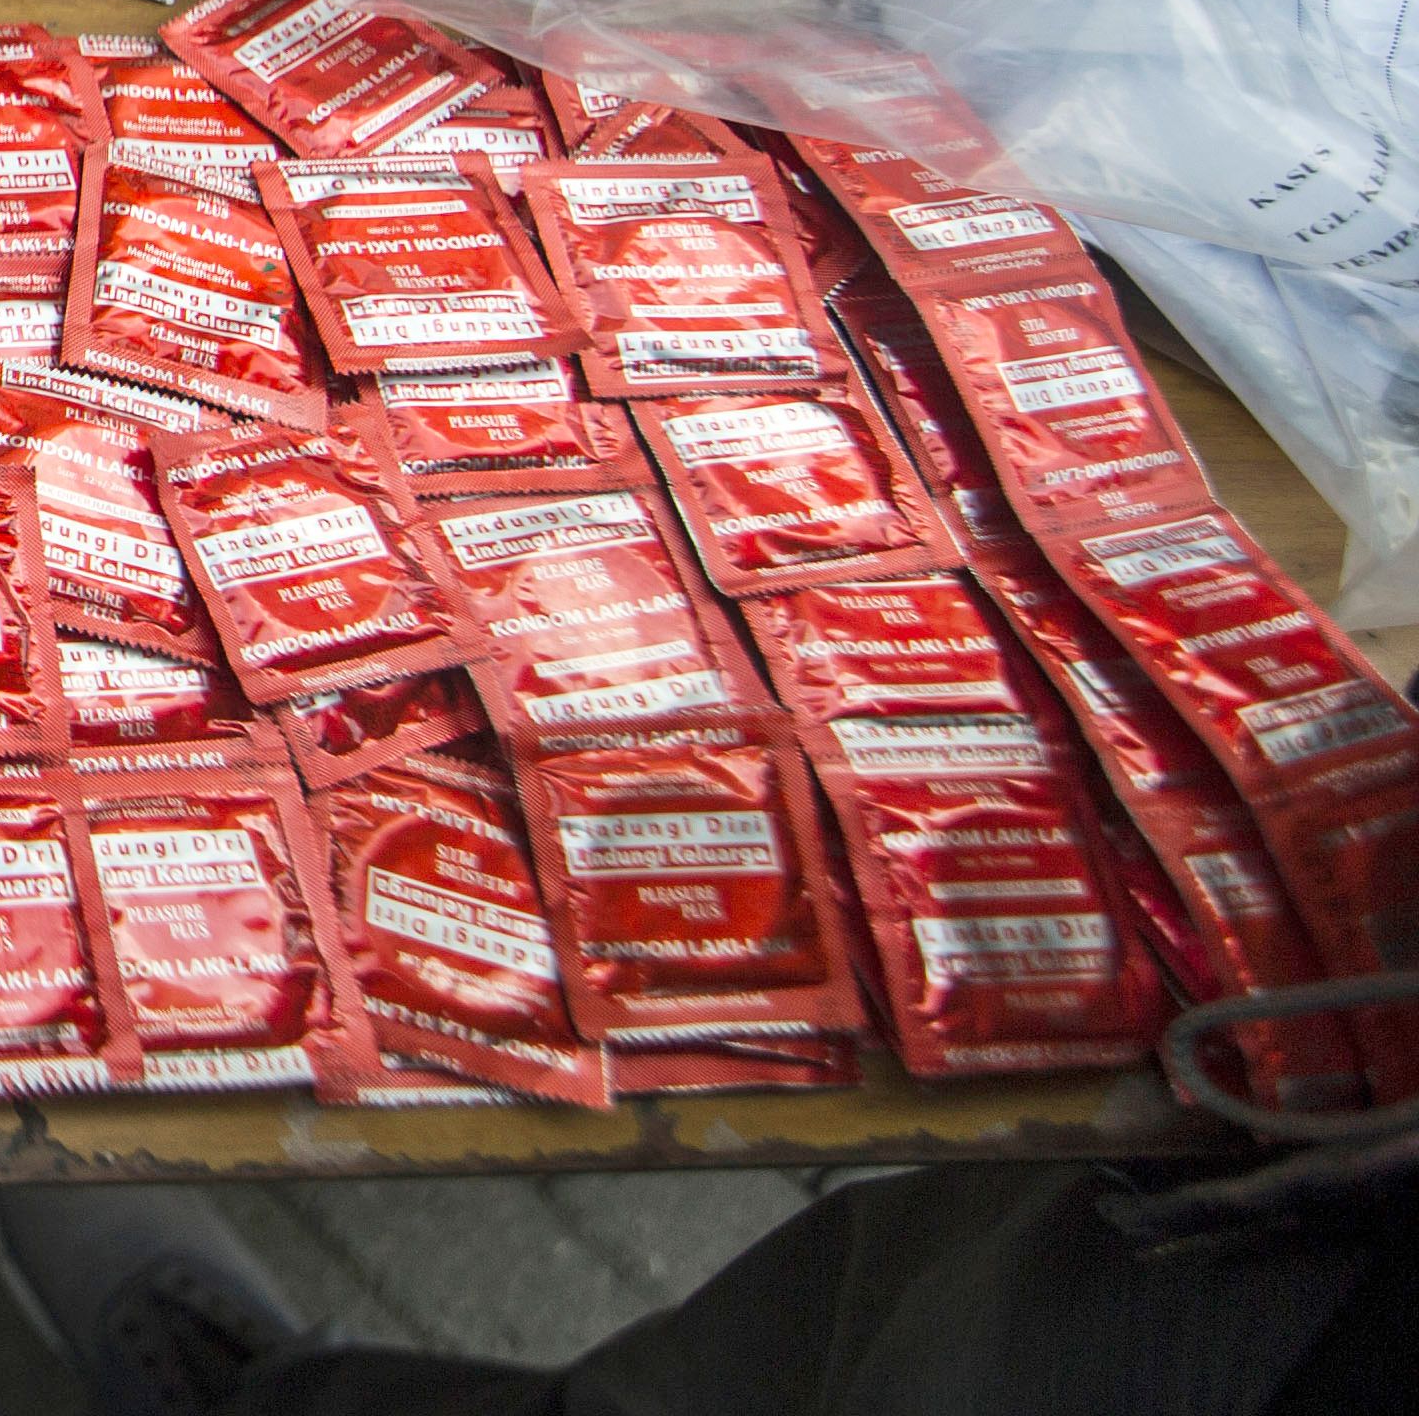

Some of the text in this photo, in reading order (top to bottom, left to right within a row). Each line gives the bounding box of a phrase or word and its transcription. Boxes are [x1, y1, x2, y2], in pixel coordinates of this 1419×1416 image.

[1249, 144, 1330, 209] KASUS
[318, 235, 503, 257] KONDOM LAKI-LAKI
[450, 414, 517, 429] PLEASURE
[489, 426, 523, 440] PLUS
[838, 594, 910, 611] PLEASURE
[880, 610, 920, 624] PLUS
[567, 845, 771, 869] Lindungi Keluarga
